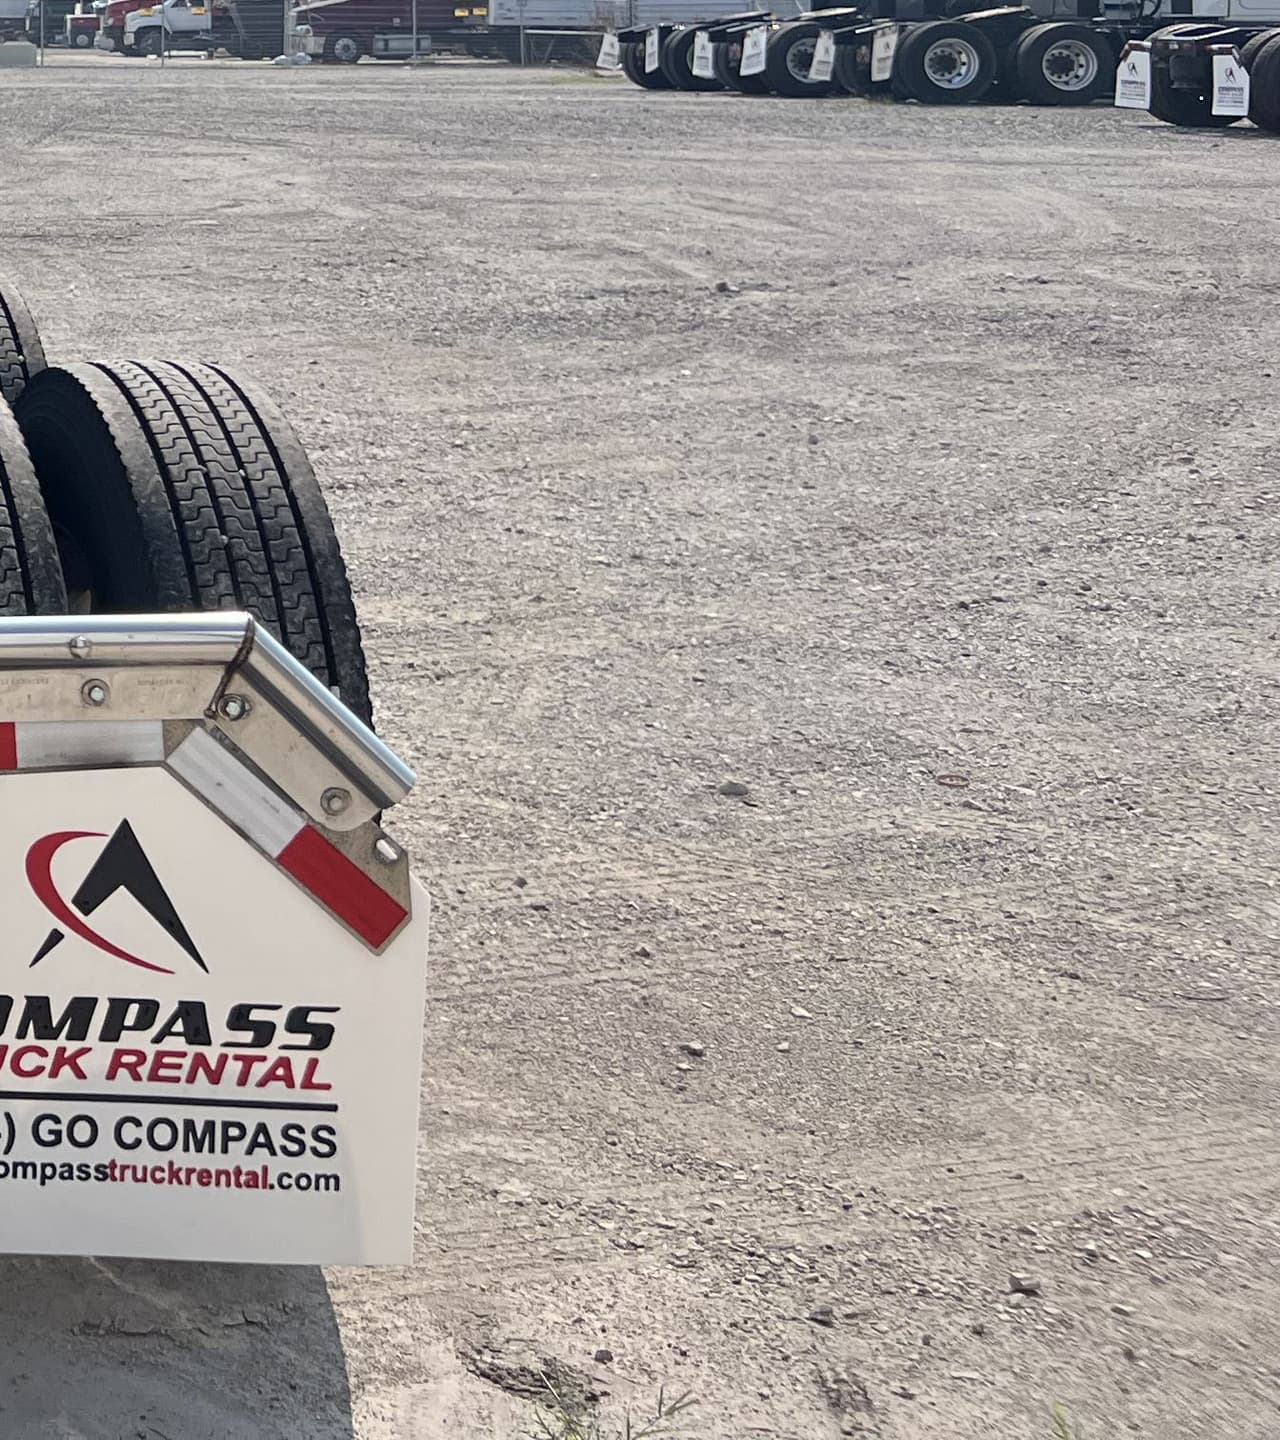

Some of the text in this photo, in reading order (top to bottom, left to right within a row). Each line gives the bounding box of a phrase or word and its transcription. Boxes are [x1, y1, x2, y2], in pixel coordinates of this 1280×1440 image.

[105, 1048, 333, 1091] RENTAL
[31, 1113, 100, 1150] GO
[113, 1116, 339, 1158] COMPASS
